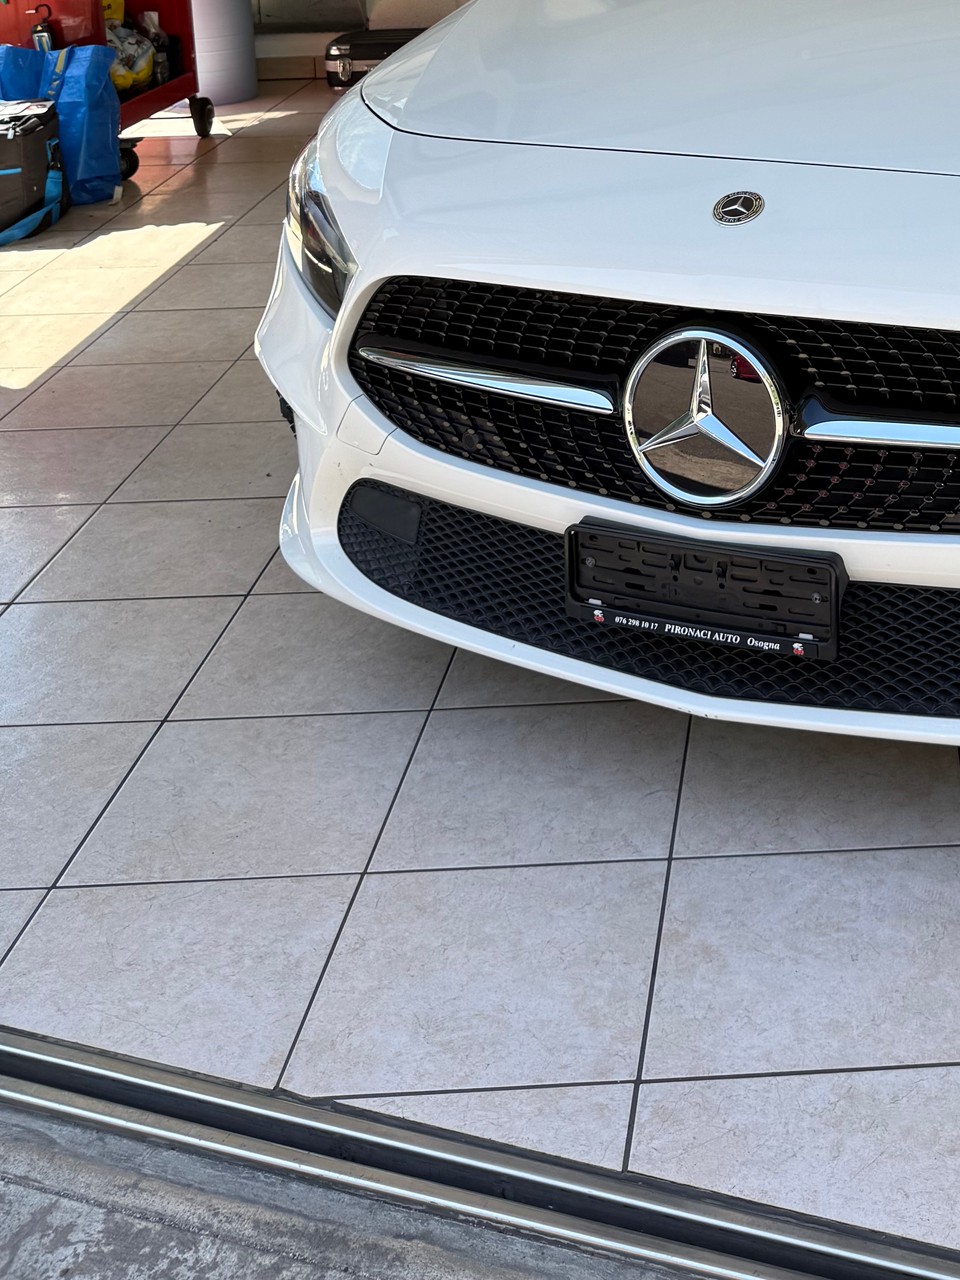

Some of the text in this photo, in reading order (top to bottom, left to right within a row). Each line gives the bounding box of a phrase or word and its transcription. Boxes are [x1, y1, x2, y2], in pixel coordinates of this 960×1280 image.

[614, 616, 780, 650] 076 298 10 17 PIRONACI AUTO Osogna
